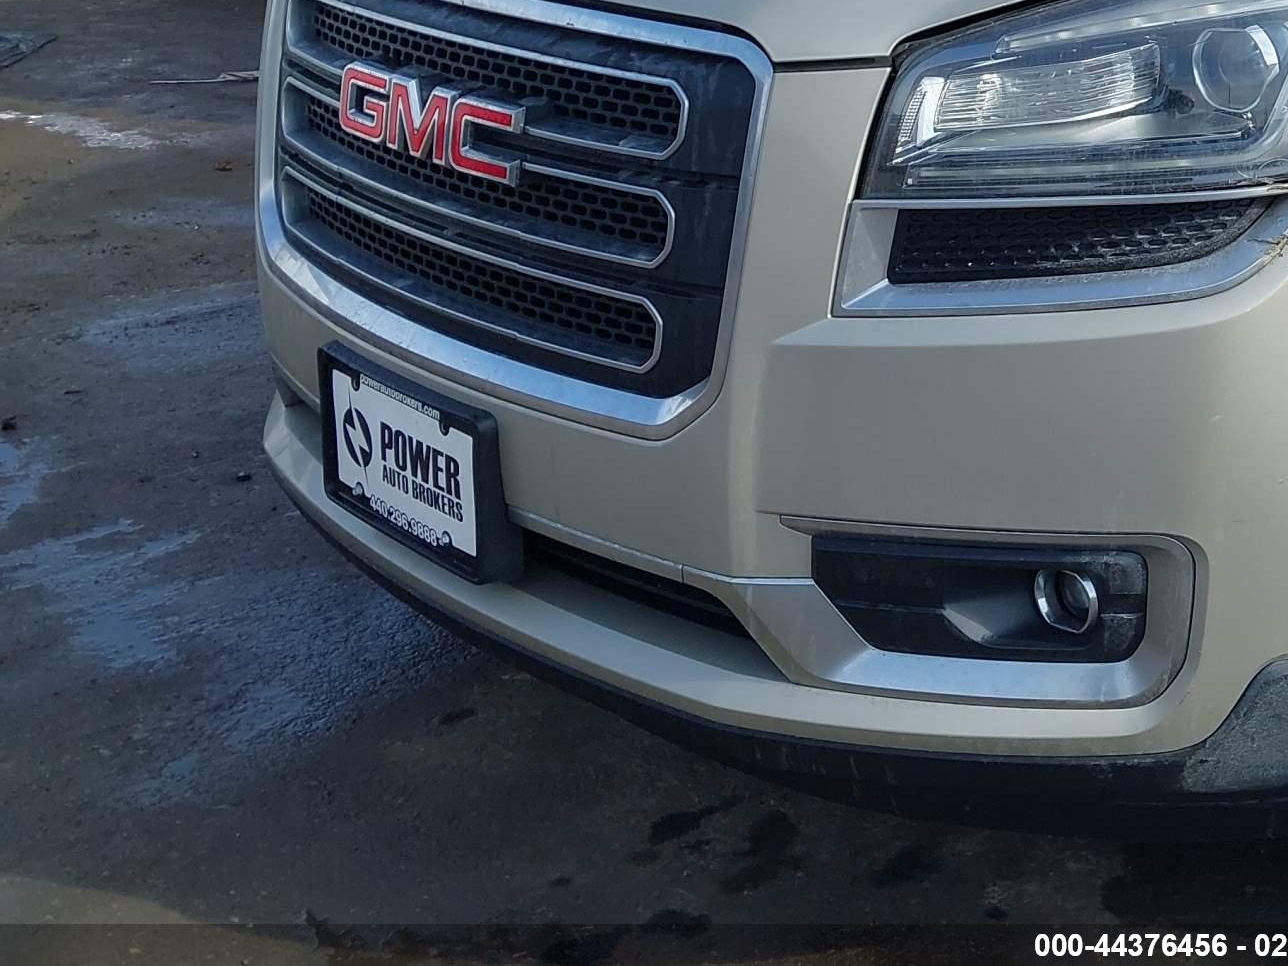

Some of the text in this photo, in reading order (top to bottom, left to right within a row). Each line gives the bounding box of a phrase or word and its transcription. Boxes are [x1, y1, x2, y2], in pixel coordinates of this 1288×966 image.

[339, 61, 525, 187] GMC
[359, 374, 440, 422] powerautobrokers.com
[380, 421, 462, 501] POWER
[369, 494, 438, 547] 440.296.9888
[382, 464, 464, 523] AUTO BROKERS
